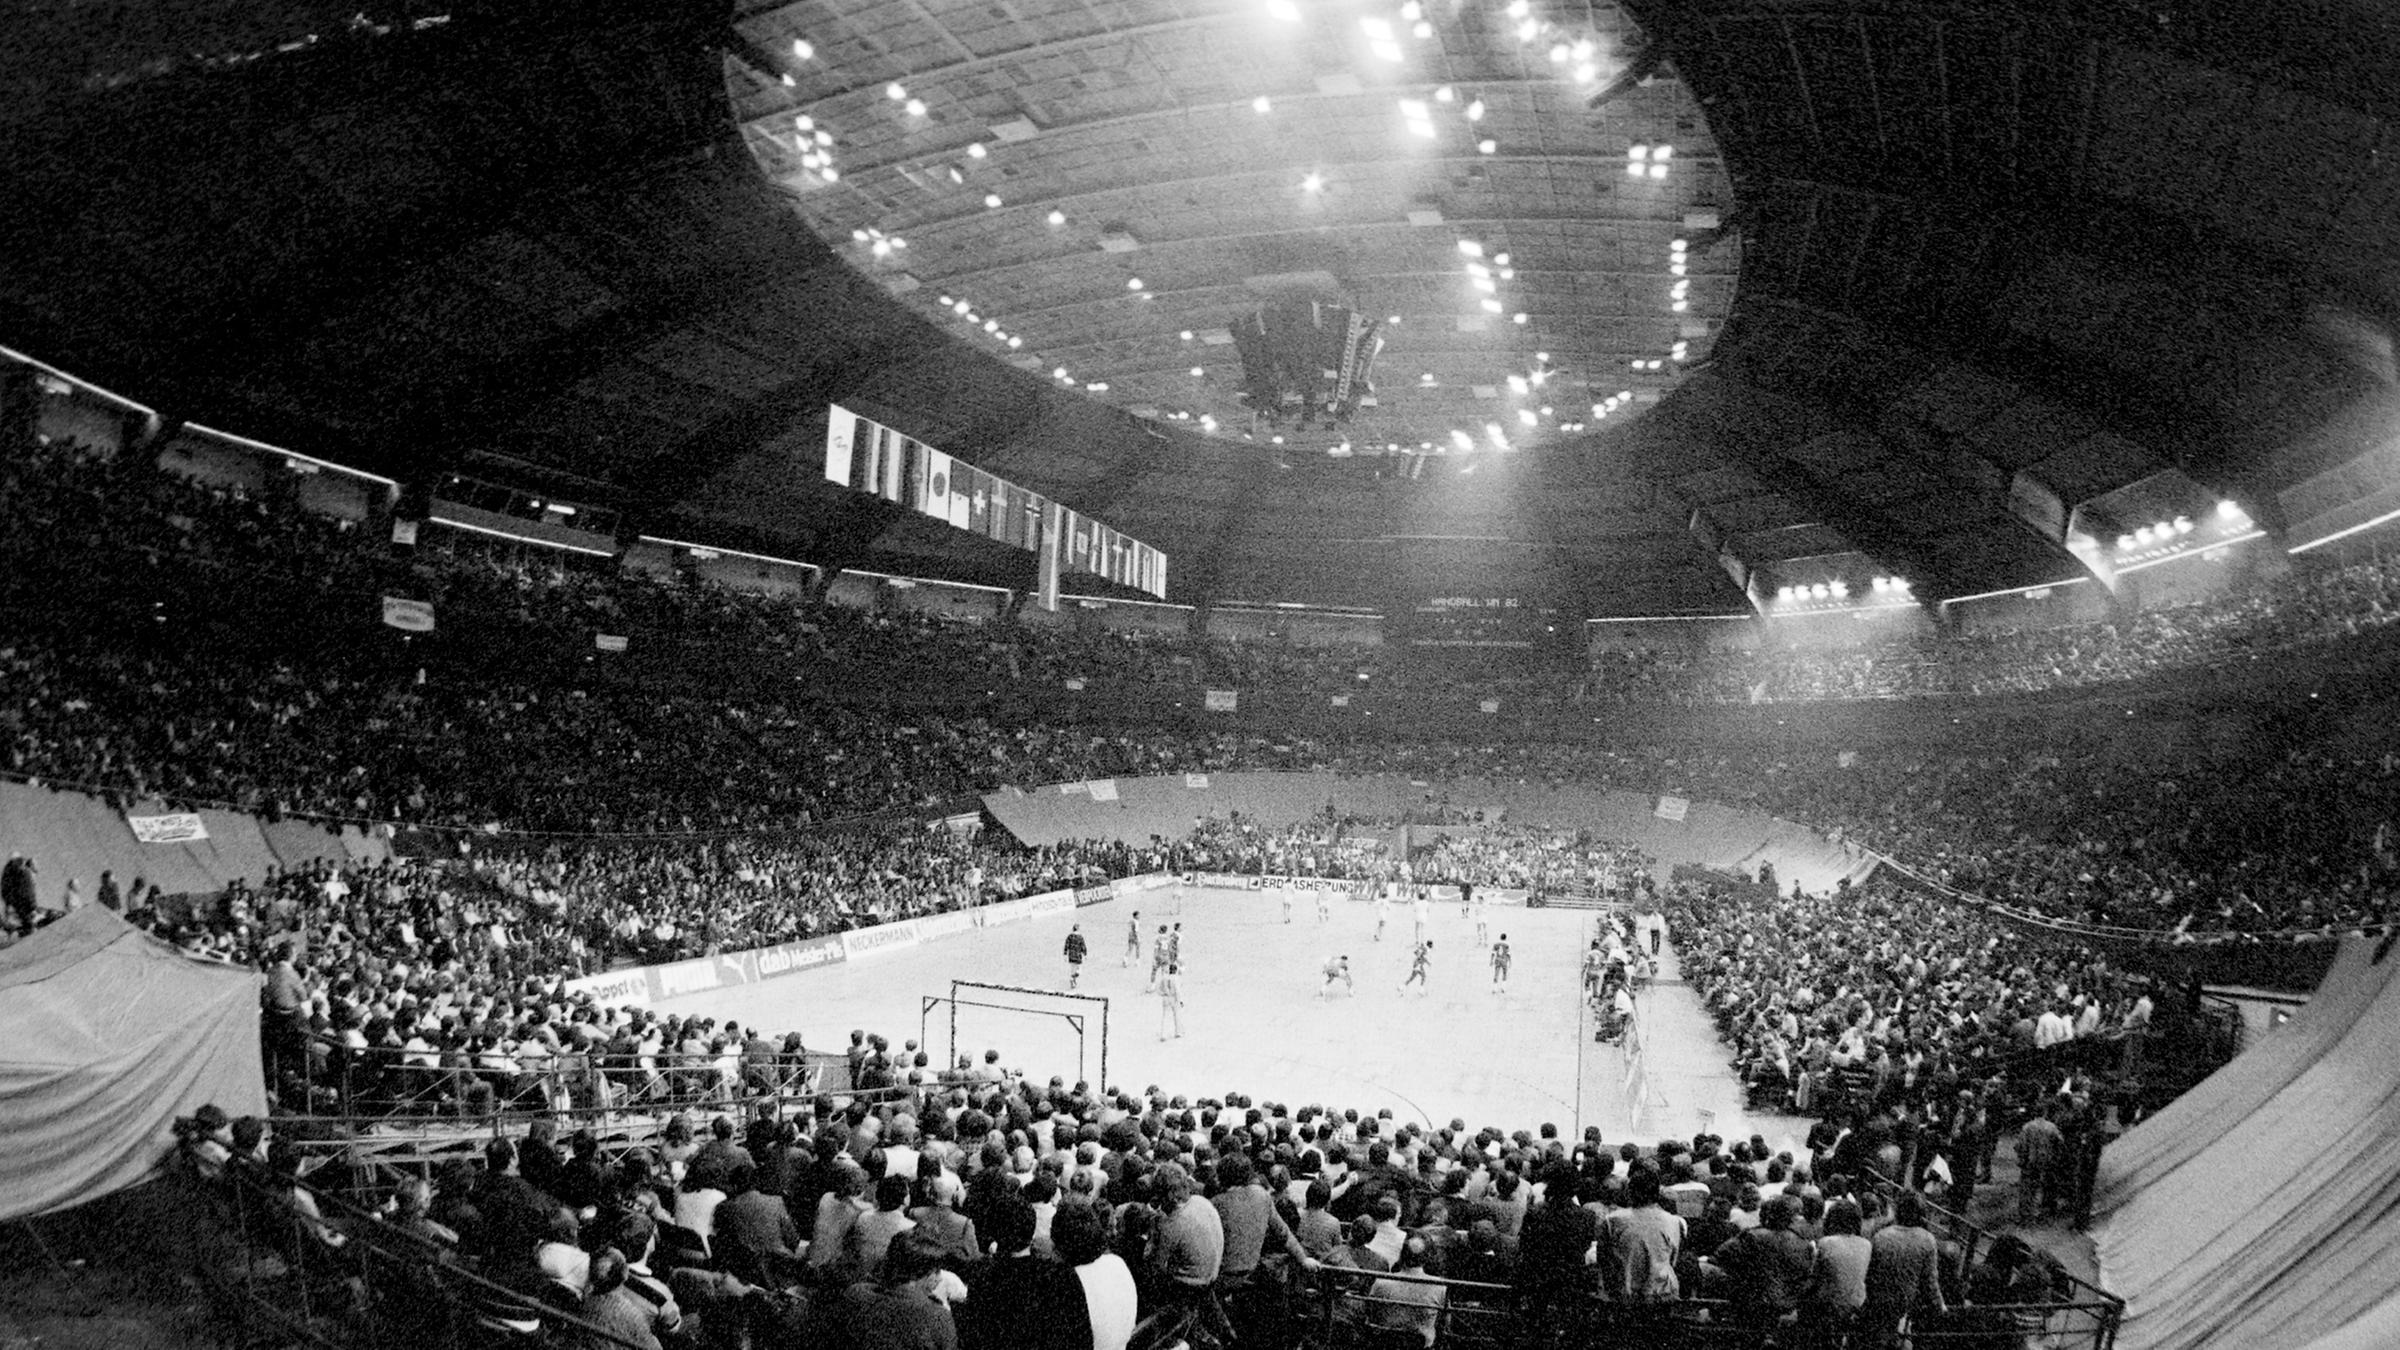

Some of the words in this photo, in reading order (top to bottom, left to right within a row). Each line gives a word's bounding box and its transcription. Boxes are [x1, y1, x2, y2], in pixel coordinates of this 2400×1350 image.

[1505, 598, 1519, 608] 82
[850, 927, 914, 952] NECKERMANN
[759, 945, 791, 975] dab
